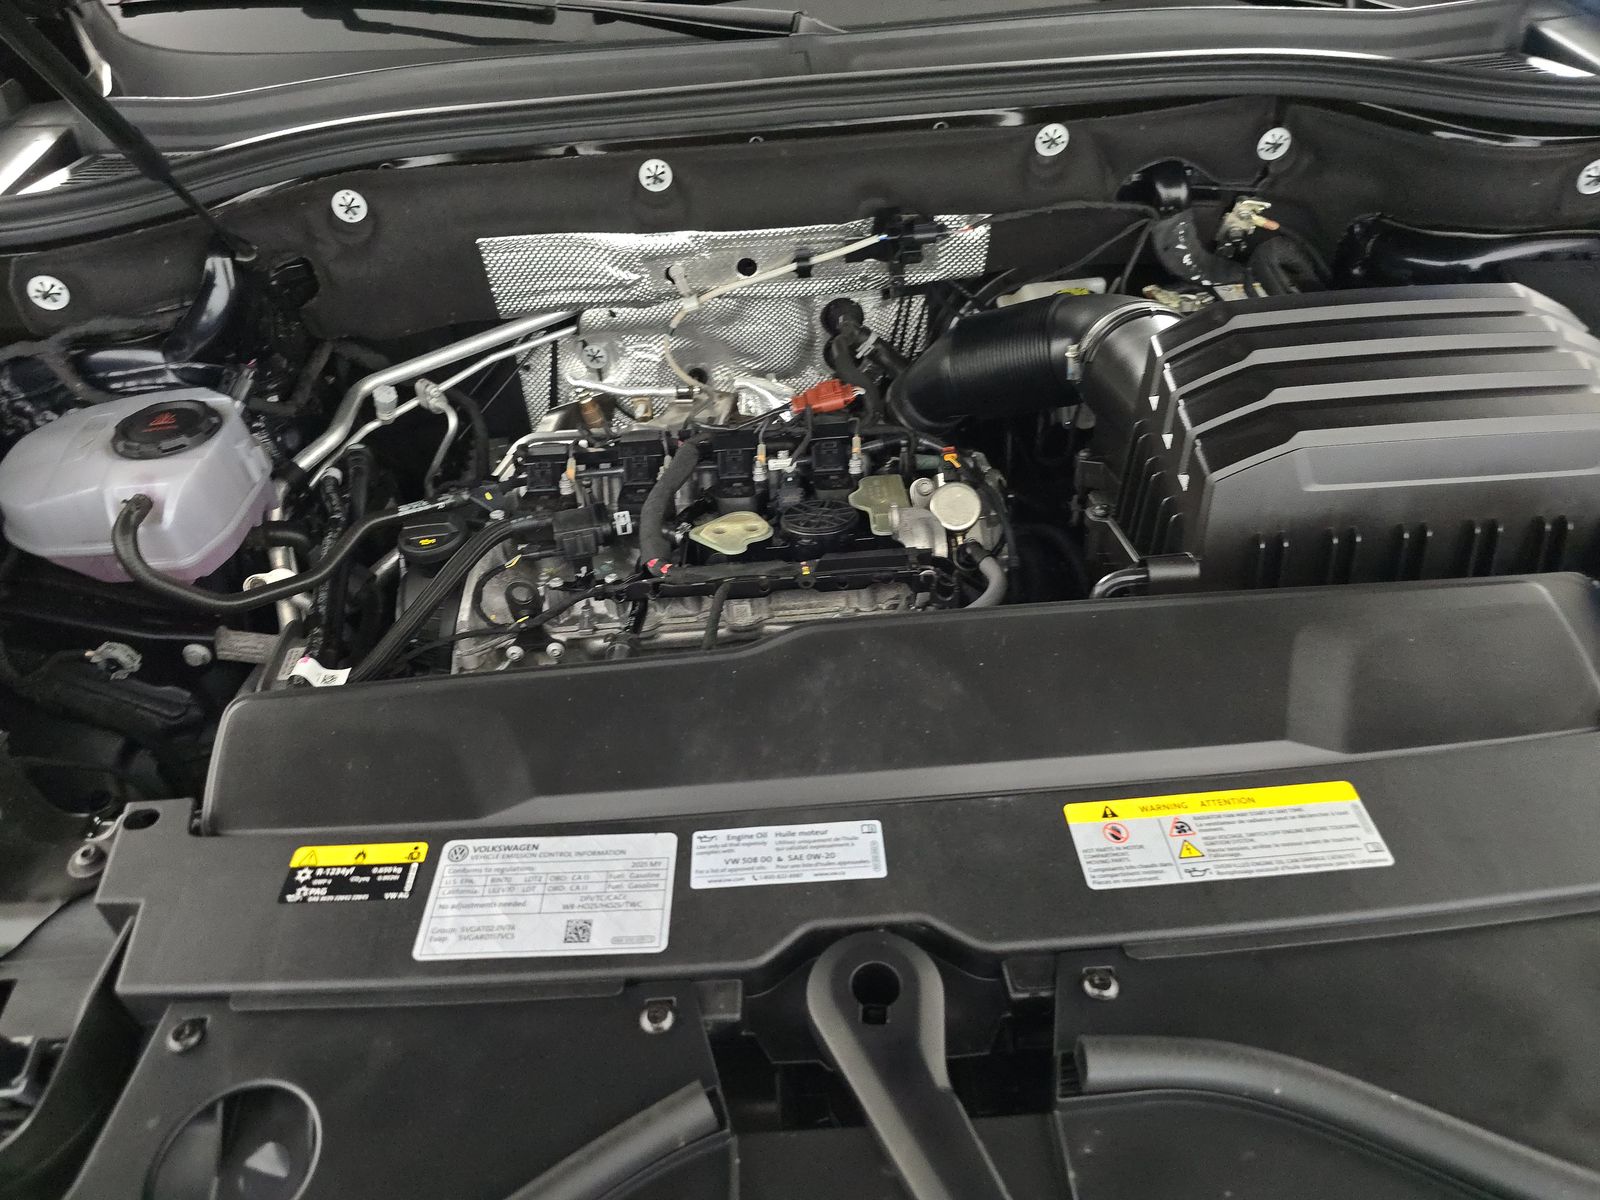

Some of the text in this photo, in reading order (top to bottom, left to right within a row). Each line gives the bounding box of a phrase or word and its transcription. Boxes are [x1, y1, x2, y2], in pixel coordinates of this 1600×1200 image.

[1138, 796, 1256, 813] WARNING ATTENTION
[727, 831, 769, 842] Engine Oil
[775, 830, 796, 838] Huile
[470, 853, 499, 861] VEHICLE
[539, 850, 573, 858] CONTROL
[574, 848, 627, 857] INFORMATION
[472, 843, 539, 854] VOLKSWAGEN
[724, 857, 741, 865] VW
[742, 856, 758, 865] 508
[760, 855, 773, 863] 00
[788, 853, 804, 861] SAE
[806, 851, 836, 861] 0W-20
